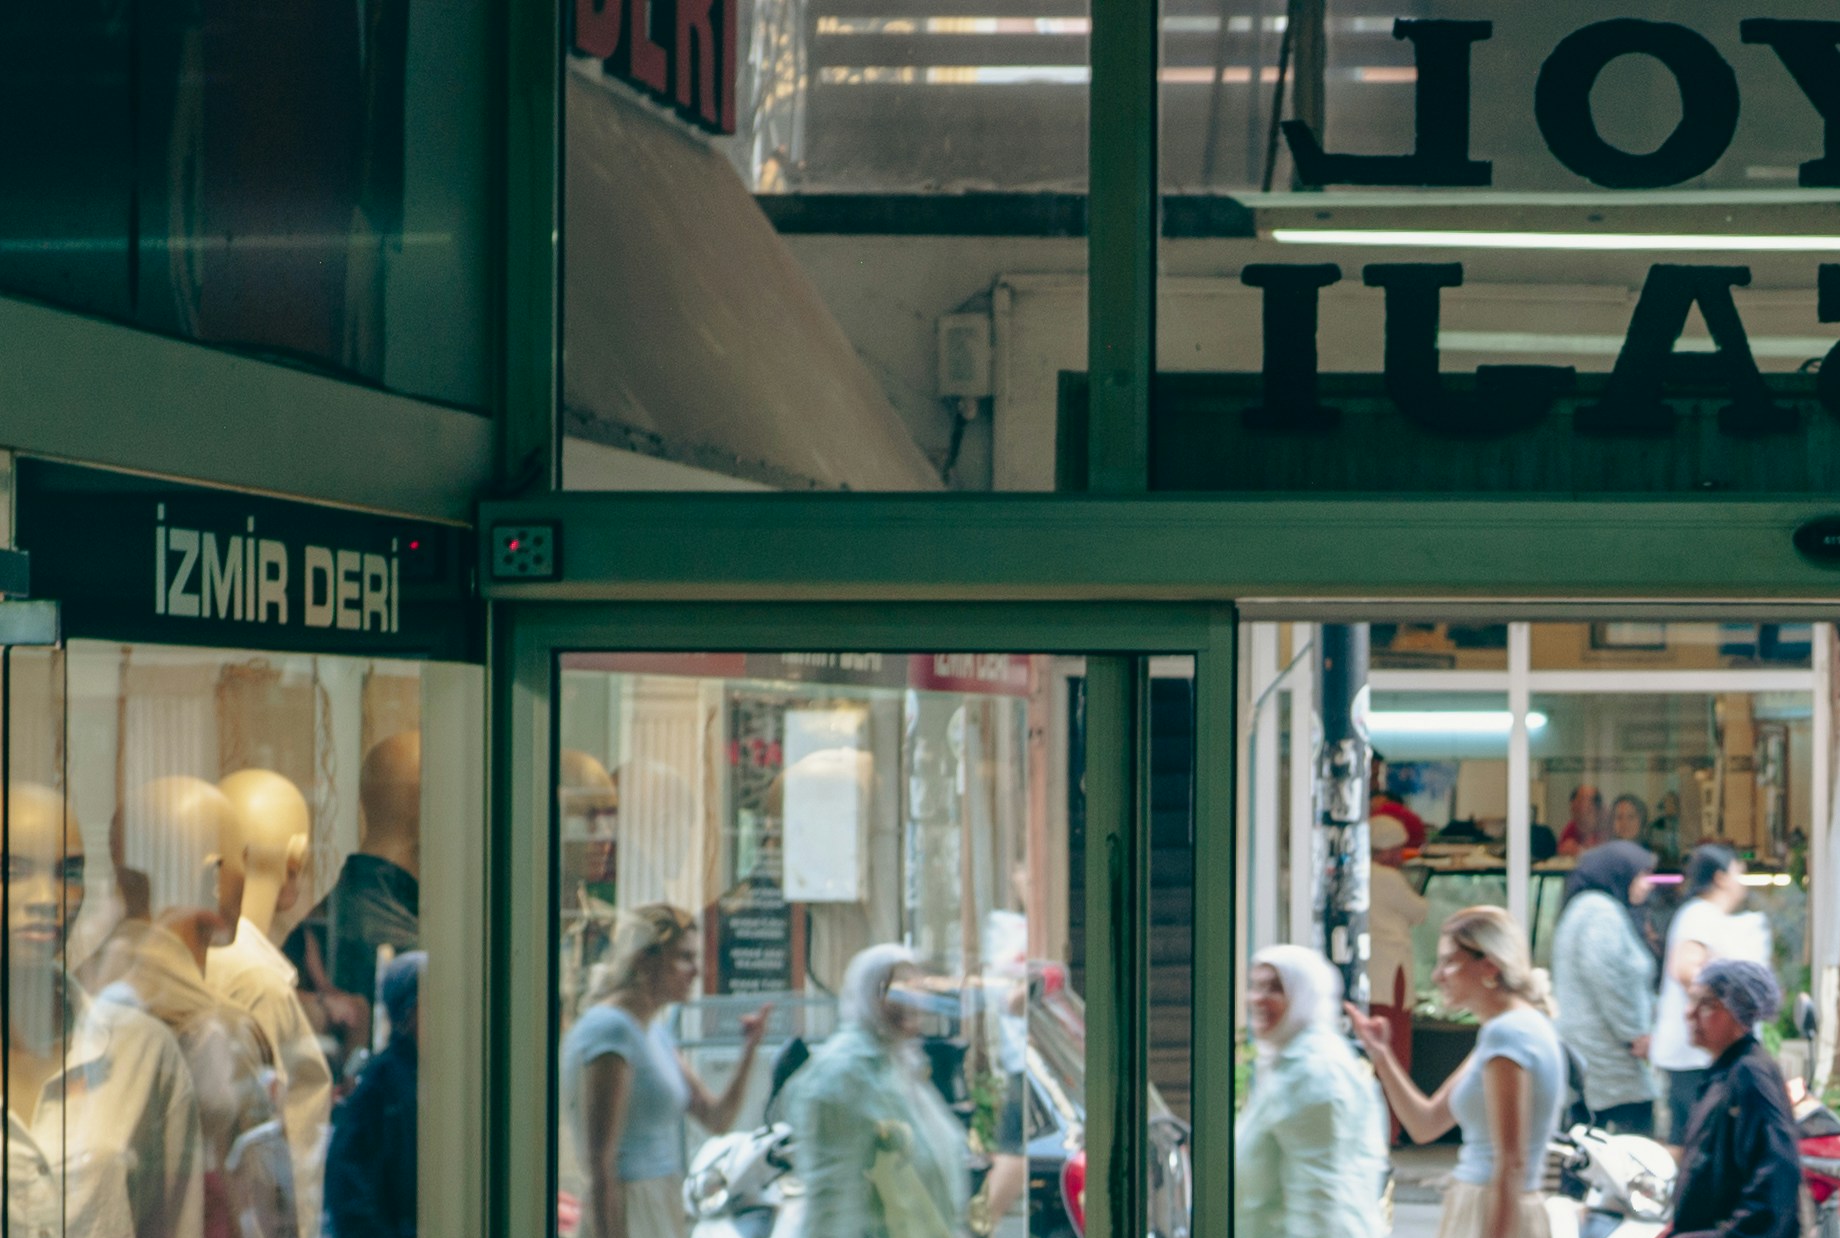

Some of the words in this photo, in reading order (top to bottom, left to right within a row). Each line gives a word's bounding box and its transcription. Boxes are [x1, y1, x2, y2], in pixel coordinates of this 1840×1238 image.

[575, 0, 736, 136] RI
[155, 502, 289, 626] İZMİR
[304, 538, 399, 633] DERİ
